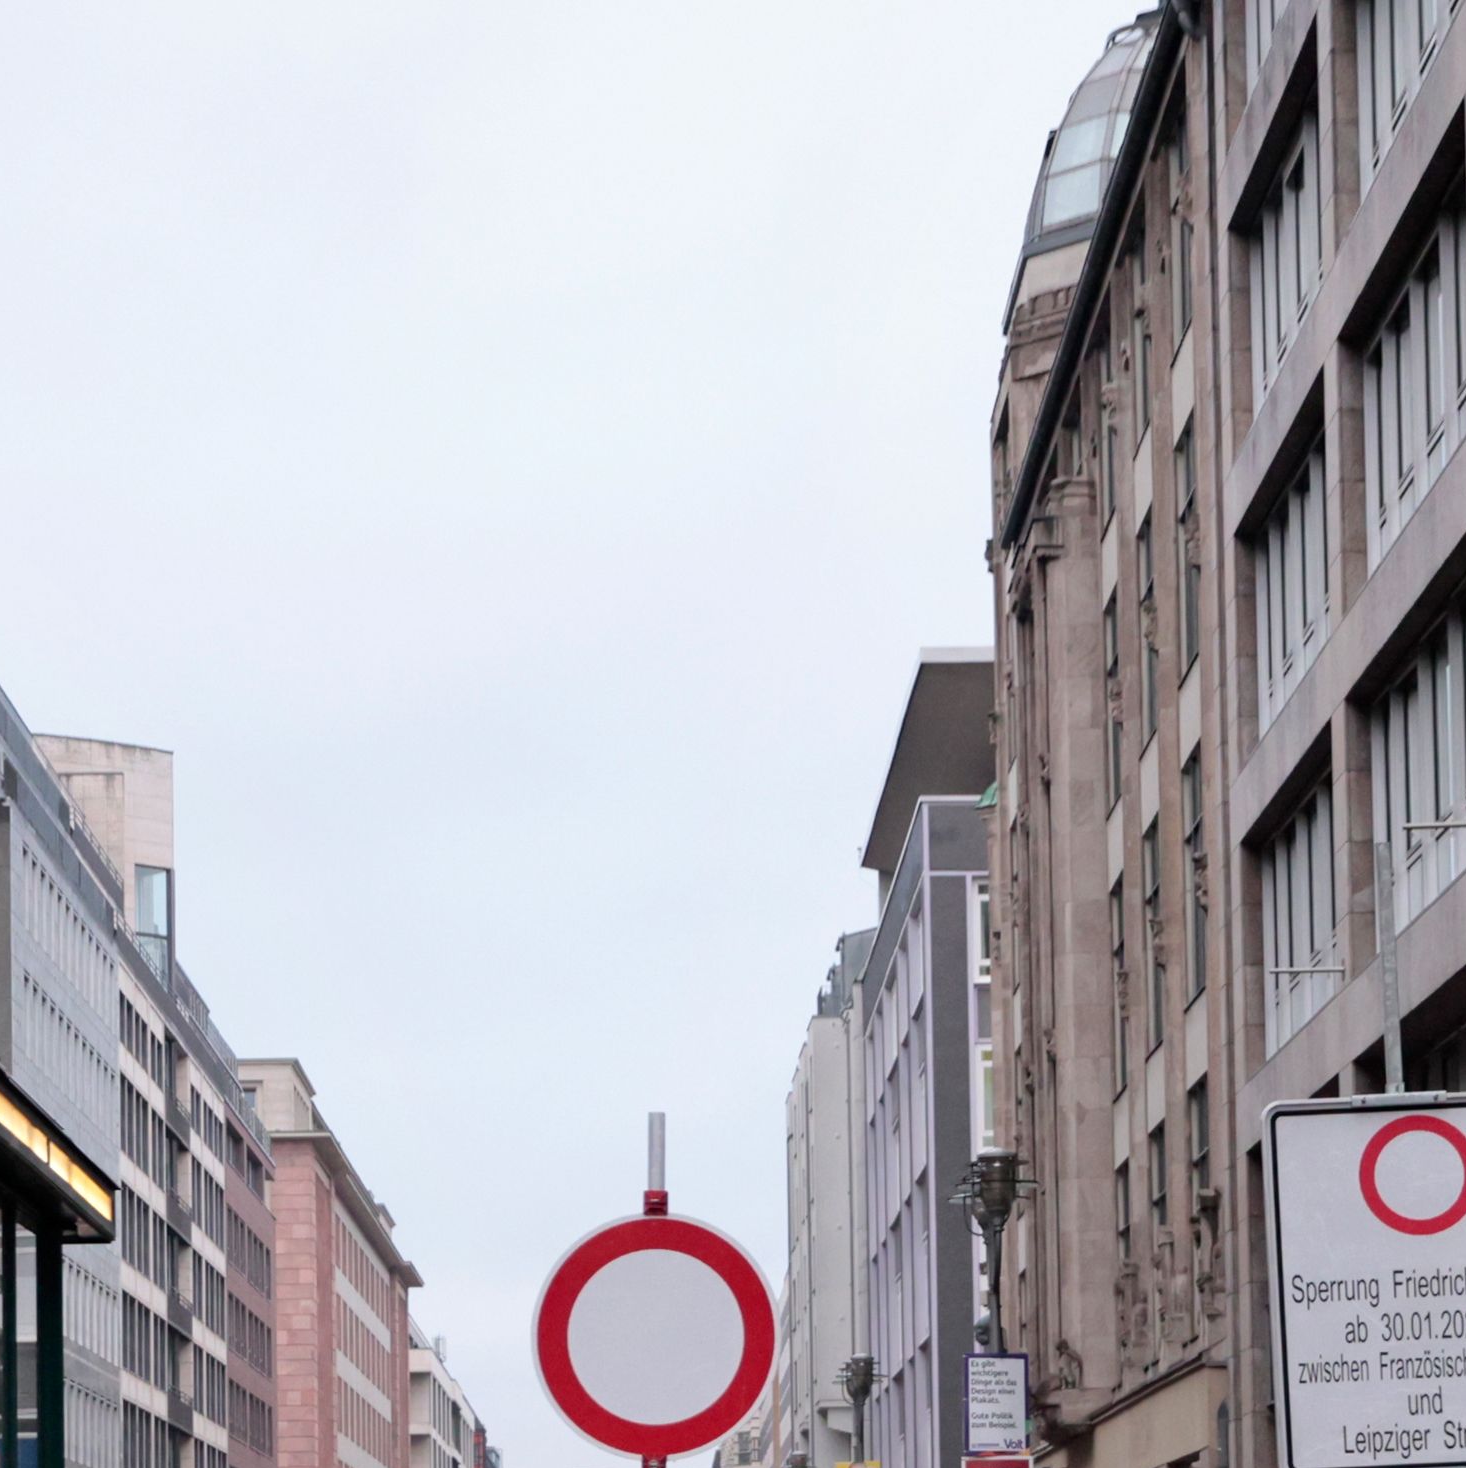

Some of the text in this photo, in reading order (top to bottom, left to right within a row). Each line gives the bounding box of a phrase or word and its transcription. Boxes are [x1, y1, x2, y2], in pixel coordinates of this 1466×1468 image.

[1291, 1274, 1381, 1310] Sperrung
[1344, 1314, 1369, 1344] ab
[1298, 1354, 1370, 1385] zwischen
[1407, 1386, 1444, 1416] und
[1003, 1438, 1024, 1449] Volt
[1343, 1424, 1431, 1460] Leipziger
